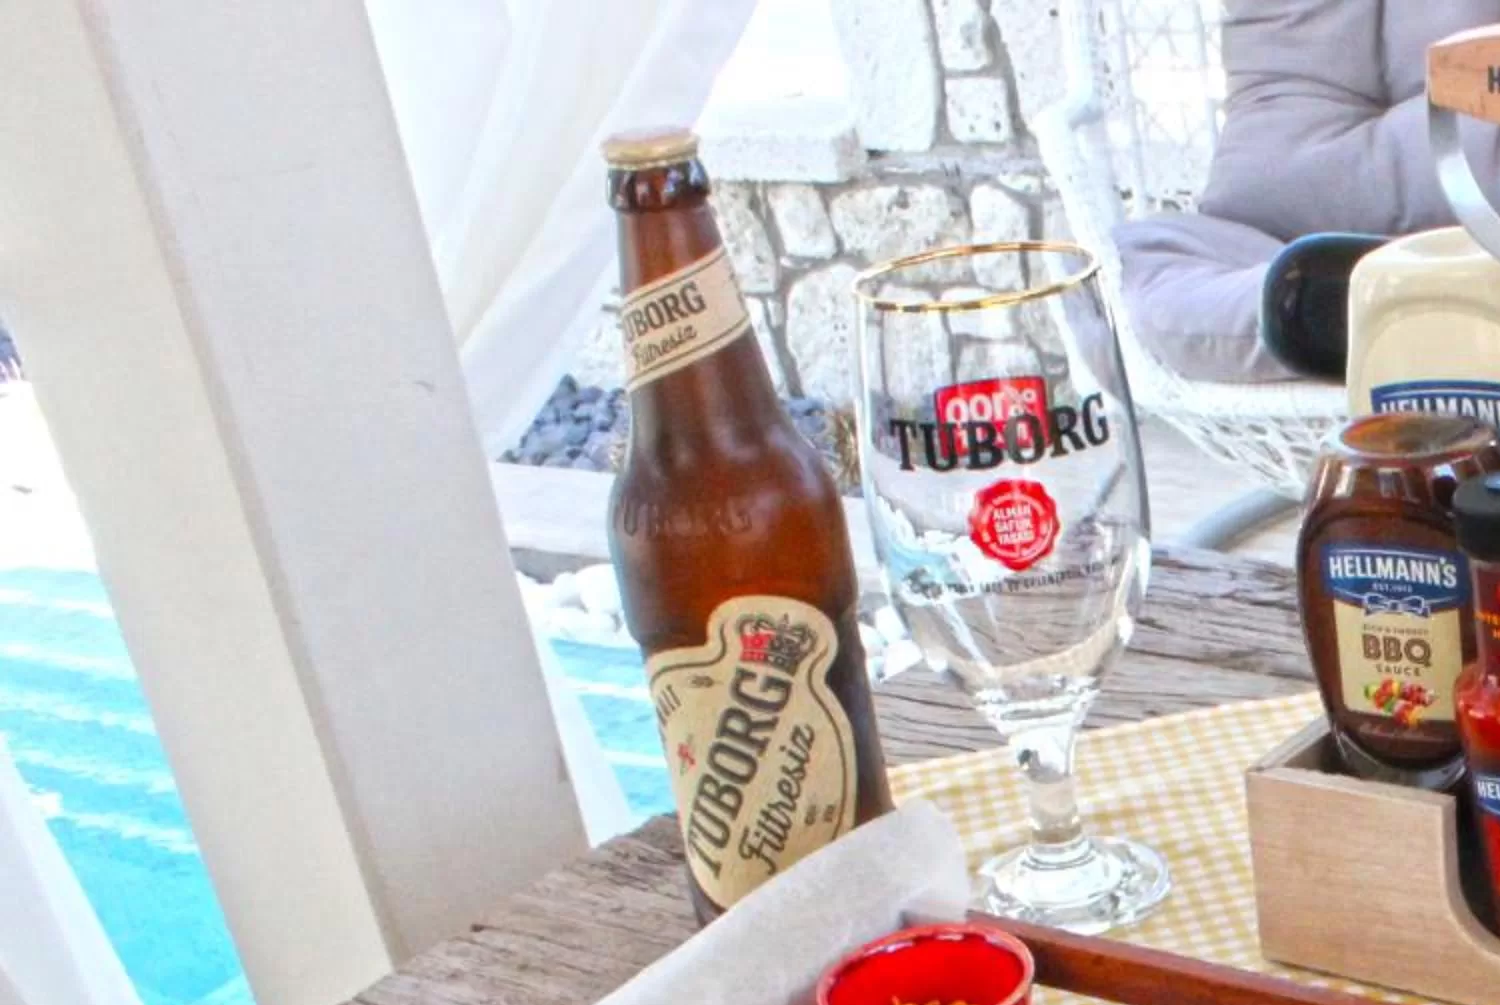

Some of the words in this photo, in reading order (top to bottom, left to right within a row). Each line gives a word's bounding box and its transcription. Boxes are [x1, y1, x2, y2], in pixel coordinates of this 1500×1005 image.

[623, 280, 707, 343] UBORG
[890, 391, 1110, 473] TUBORG
[1329, 555, 1458, 589] HELLMANN'S
[1362, 634, 1433, 668] BBQ
[1376, 664, 1421, 677] SAUCE
[687, 667, 793, 880] TUBORG
[738, 723, 816, 876] Filtresiz
